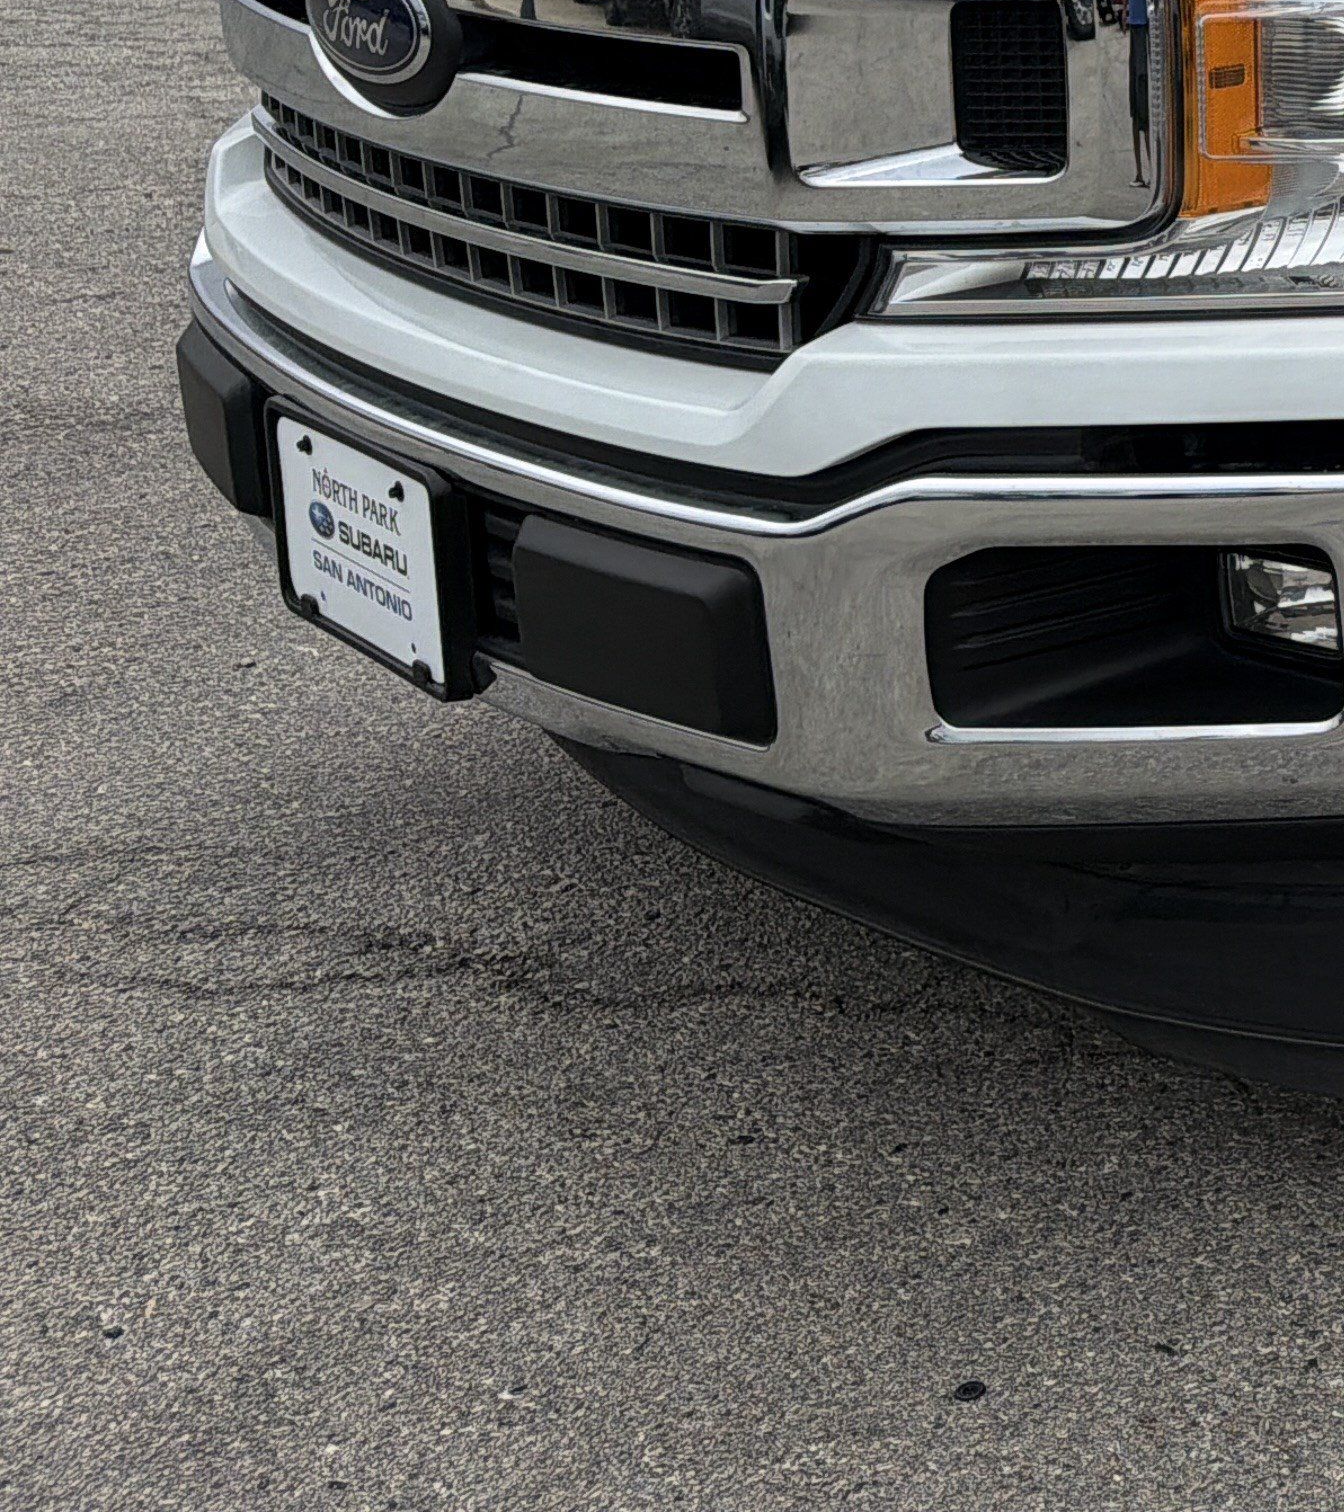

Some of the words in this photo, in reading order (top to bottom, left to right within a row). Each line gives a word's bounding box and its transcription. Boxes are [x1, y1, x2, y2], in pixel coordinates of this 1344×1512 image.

[311, 468, 359, 515] NORTH
[361, 493, 401, 536] PARK
[337, 520, 409, 576] SUBARU
[312, 549, 344, 583] SAN
[346, 569, 413, 621] ANTONIO
